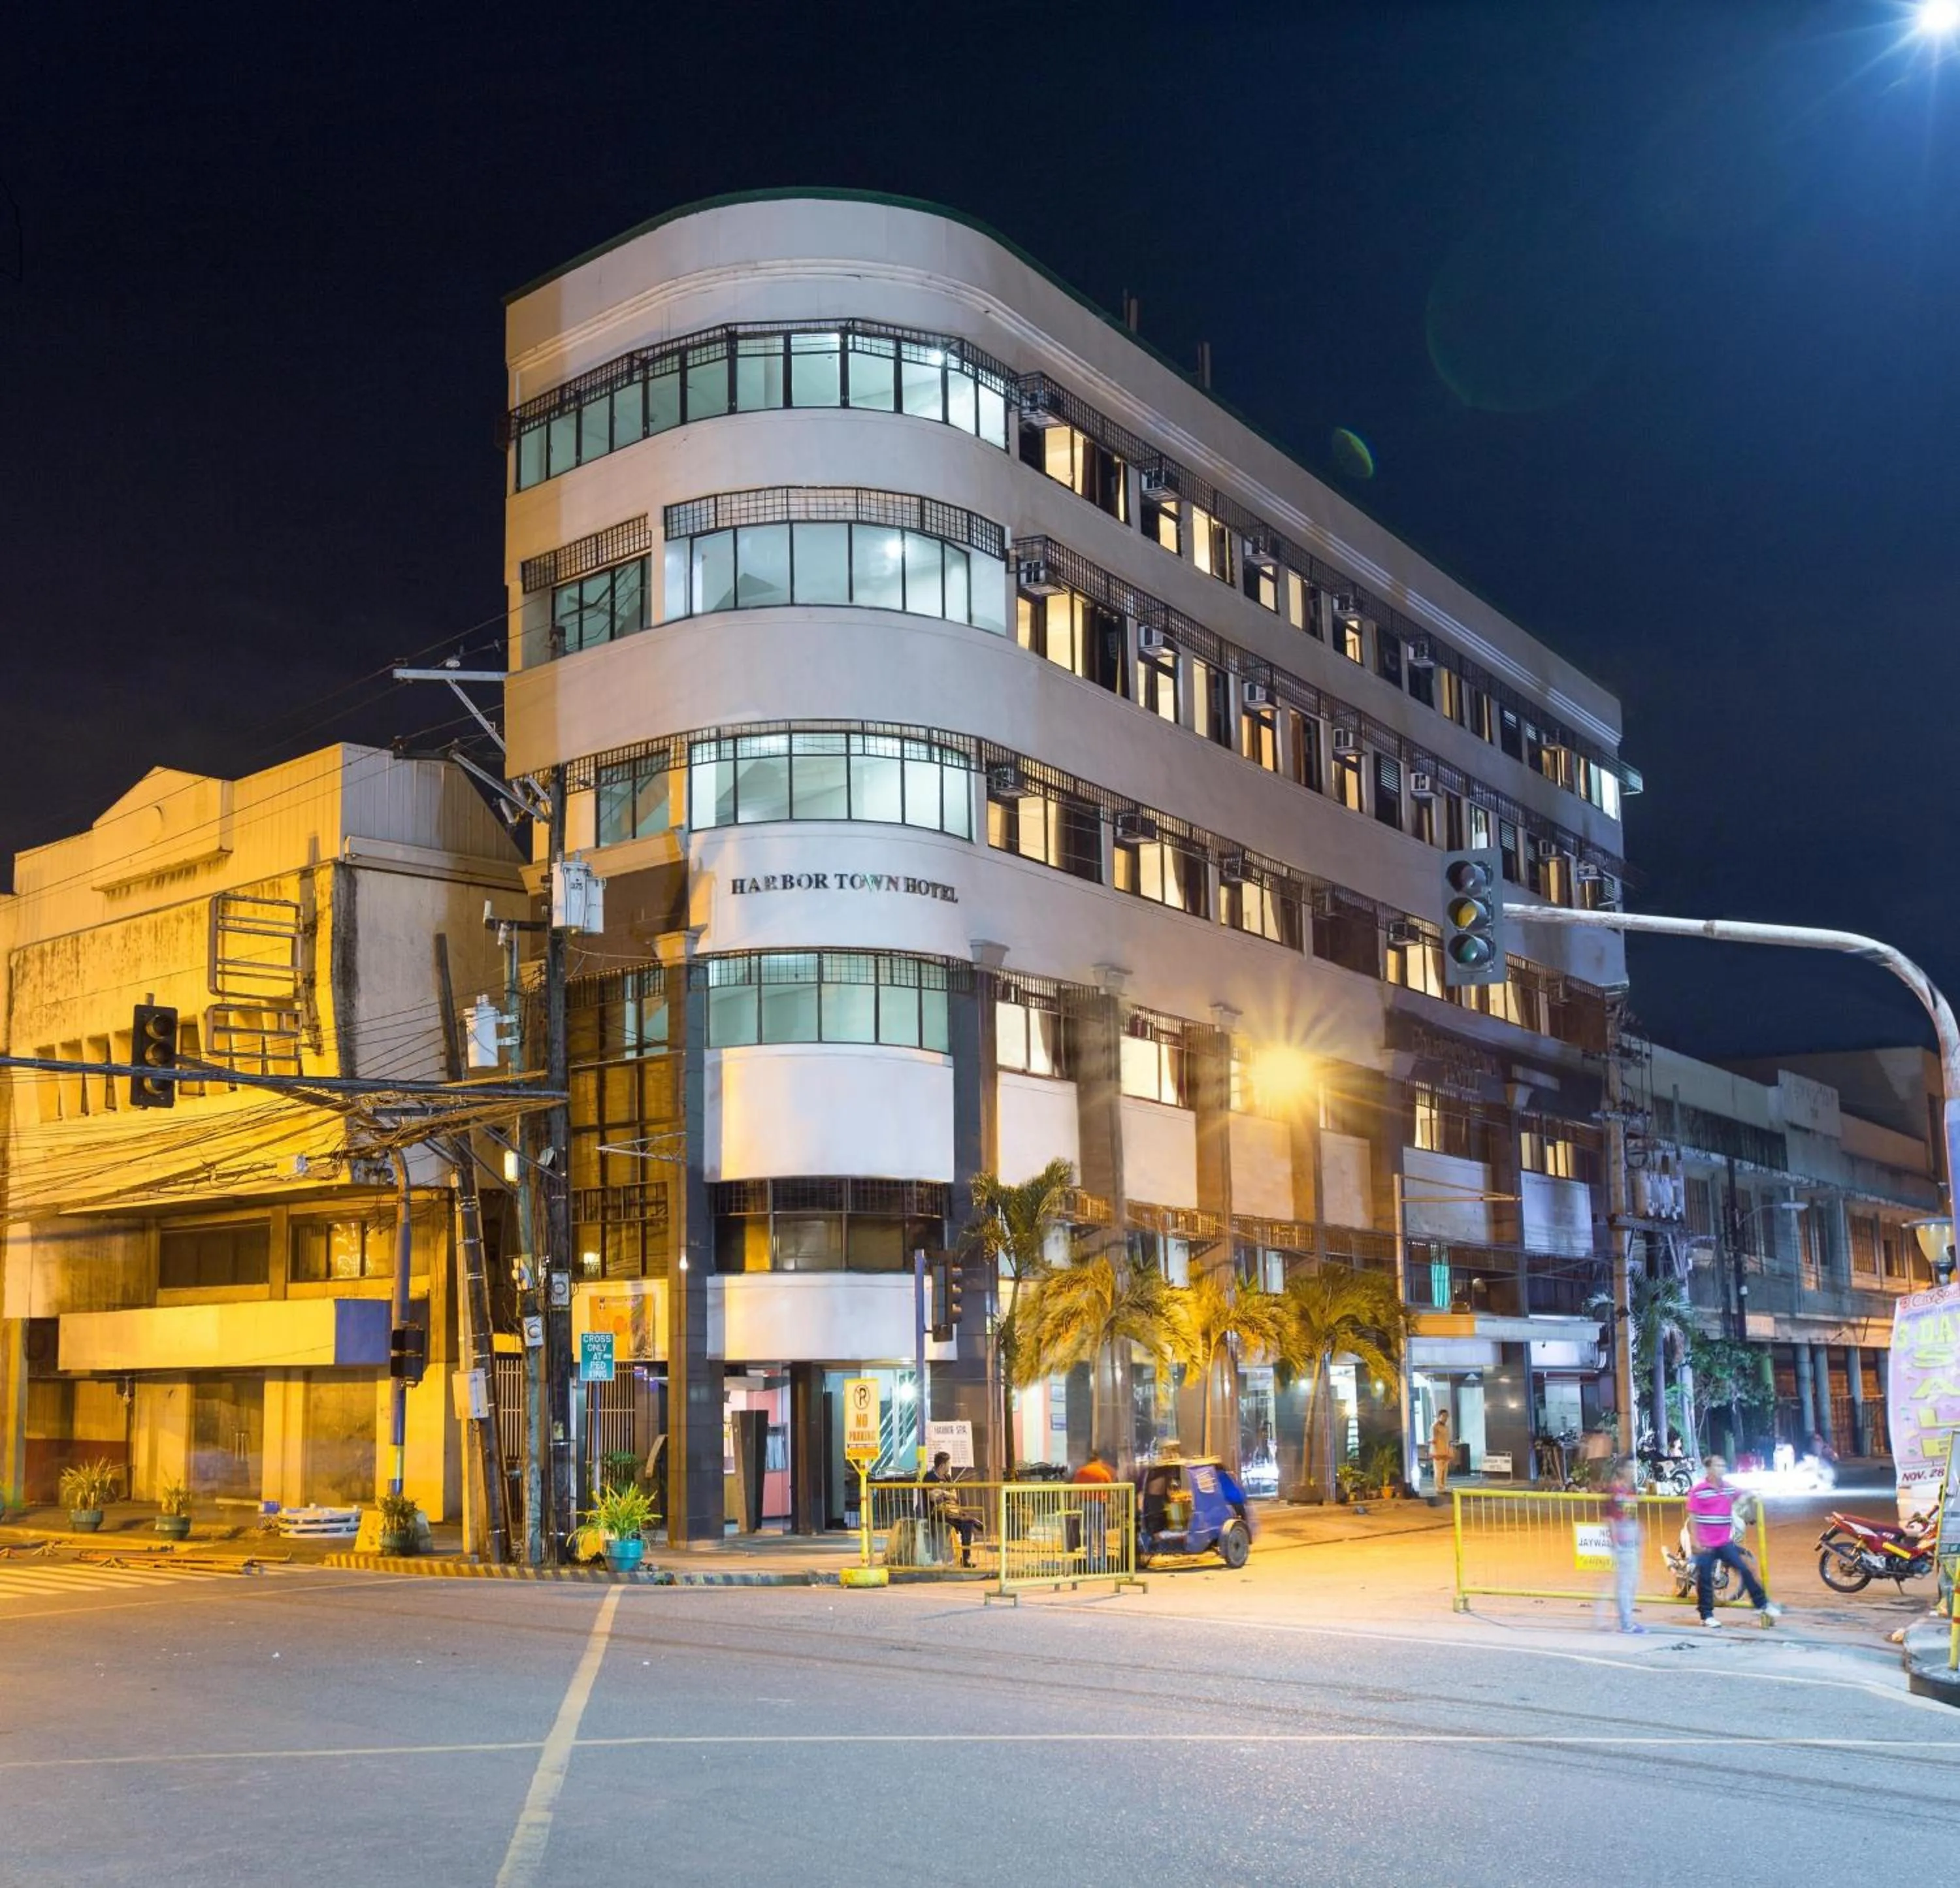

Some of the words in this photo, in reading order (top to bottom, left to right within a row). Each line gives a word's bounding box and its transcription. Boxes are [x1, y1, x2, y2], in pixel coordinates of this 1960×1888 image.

[731, 873, 828, 895] HARBOR
[834, 873, 900, 892] TOWN
[904, 877, 959, 903] HOTEL
[1916, 1313, 1960, 1344] DA
[593, 1352, 602, 1360] AT
[590, 1361, 606, 1370] PED
[856, 1413, 868, 1427] NO
[849, 1431, 876, 1441] PARKING
[1902, 1470, 1927, 1482] NOV.
[1929, 1467, 1944, 1478] 28
